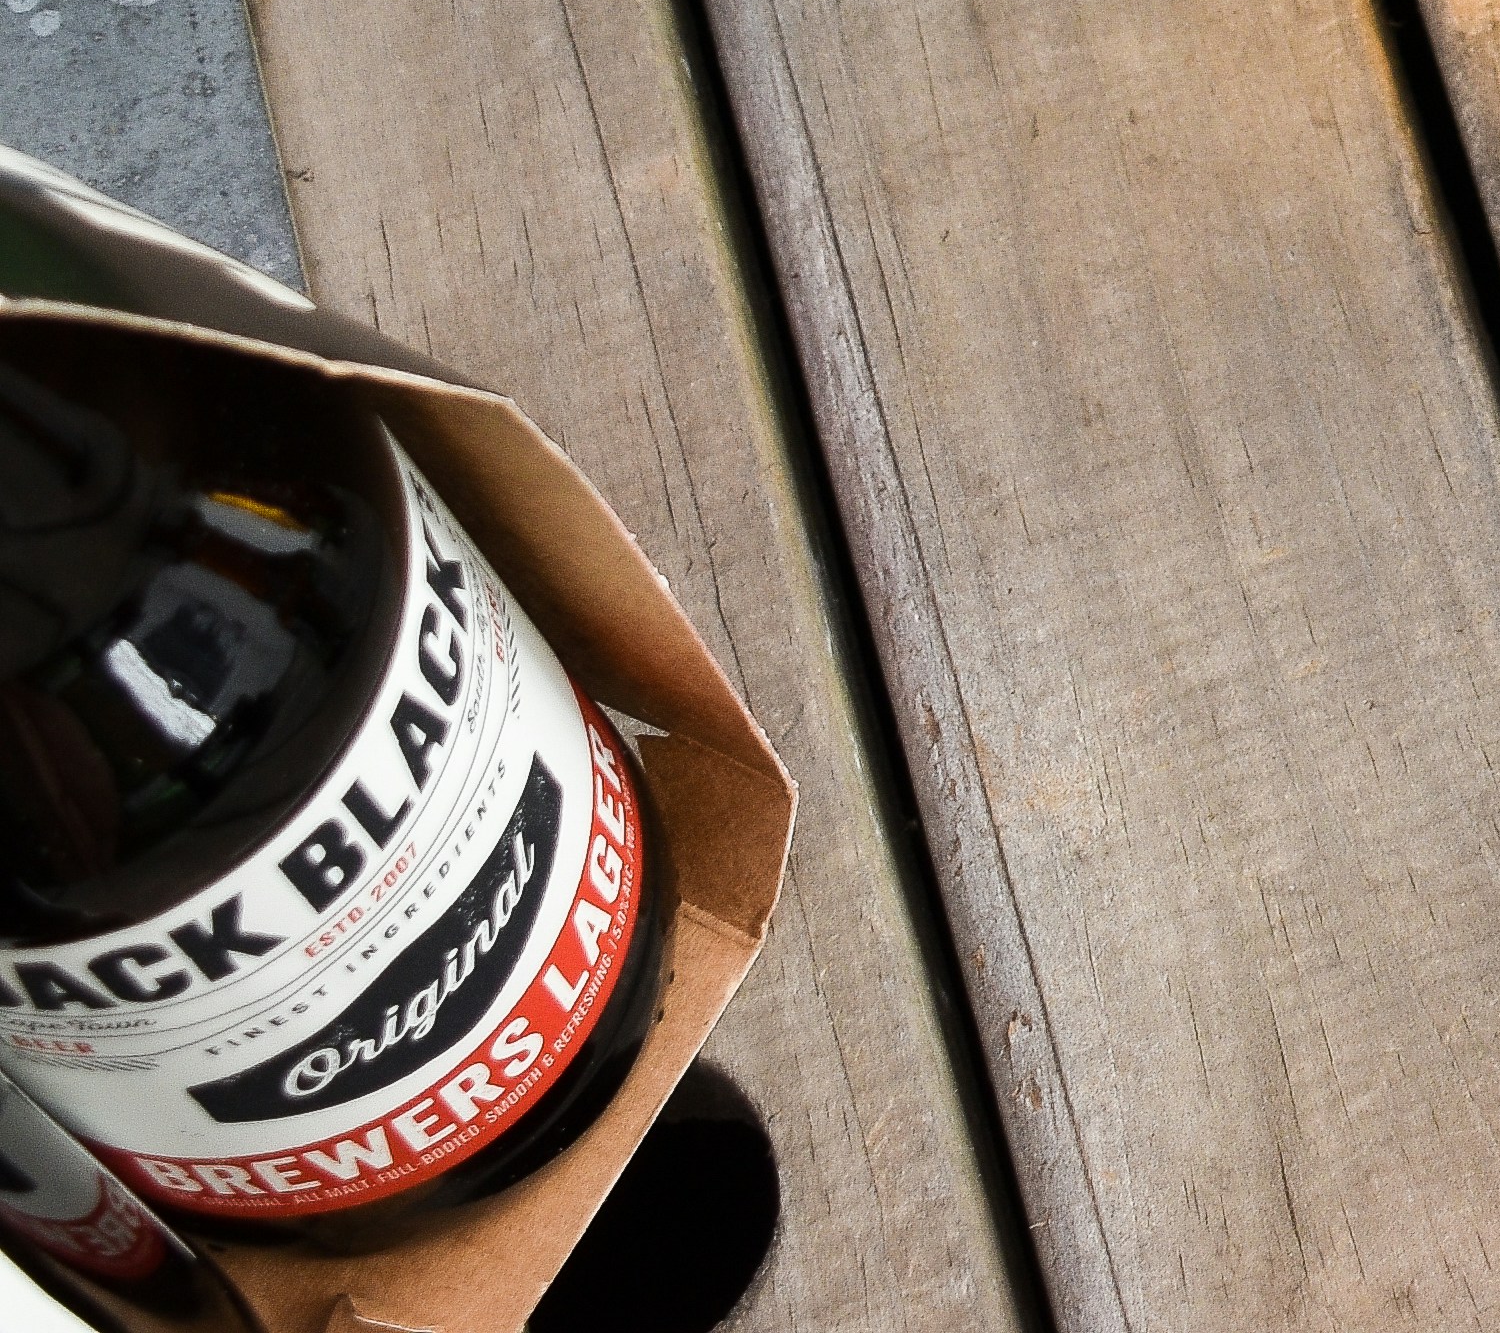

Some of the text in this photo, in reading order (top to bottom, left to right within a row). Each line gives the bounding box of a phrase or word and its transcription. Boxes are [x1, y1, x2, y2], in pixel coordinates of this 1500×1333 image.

[135, 723, 626, 1199] BREWERS LAGER
[205, 759, 512, 1057] FINEST INGREDIENTS
[283, 830, 545, 1100] Original
[304, 899, 372, 959] ESTD.
[372, 841, 421, 900] 2007
[485, 1066, 543, 1124] SMOOTH
